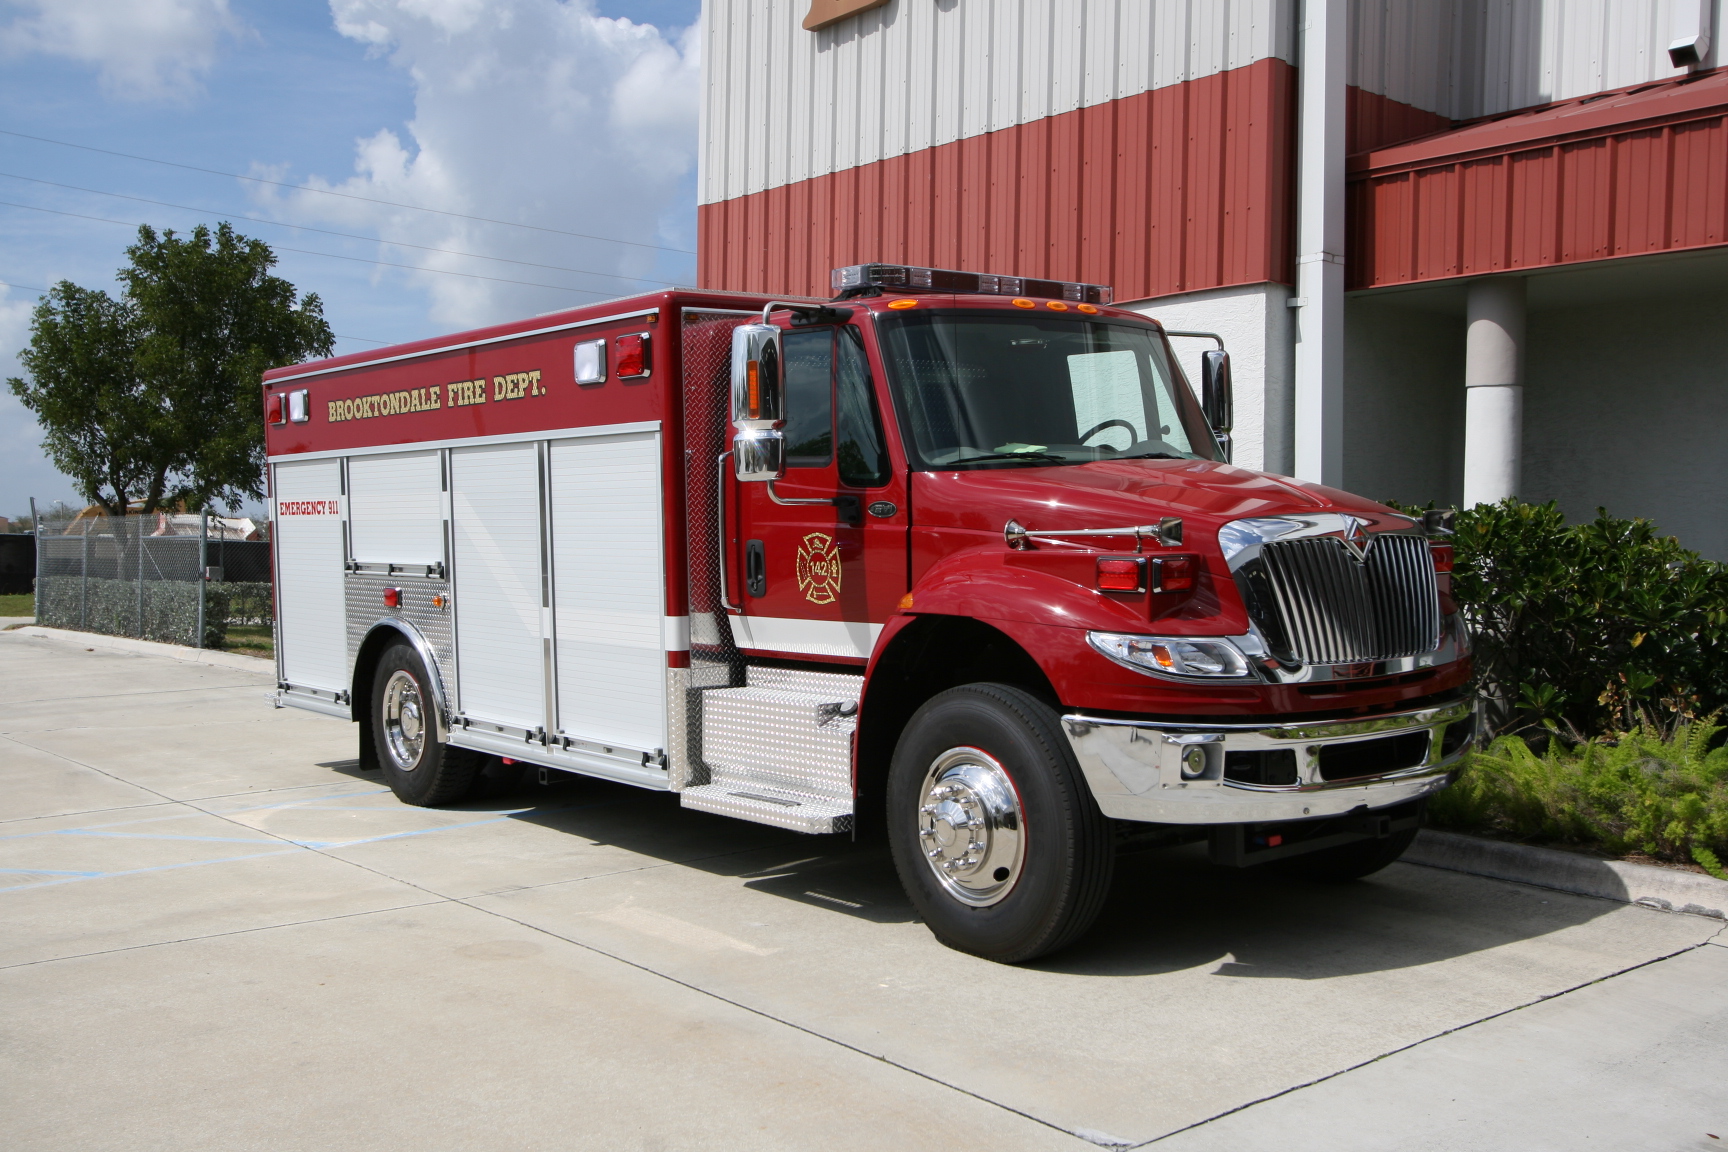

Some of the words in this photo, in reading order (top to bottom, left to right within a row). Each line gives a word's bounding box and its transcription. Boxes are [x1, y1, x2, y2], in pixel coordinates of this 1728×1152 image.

[328, 385, 441, 422] BROOKTONDALE
[447, 379, 486, 407] FIRE
[493, 370, 547, 401] DEPT.
[280, 501, 326, 515] EMERGENCY
[329, 501, 338, 514] 911
[810, 561, 828, 576] 142
